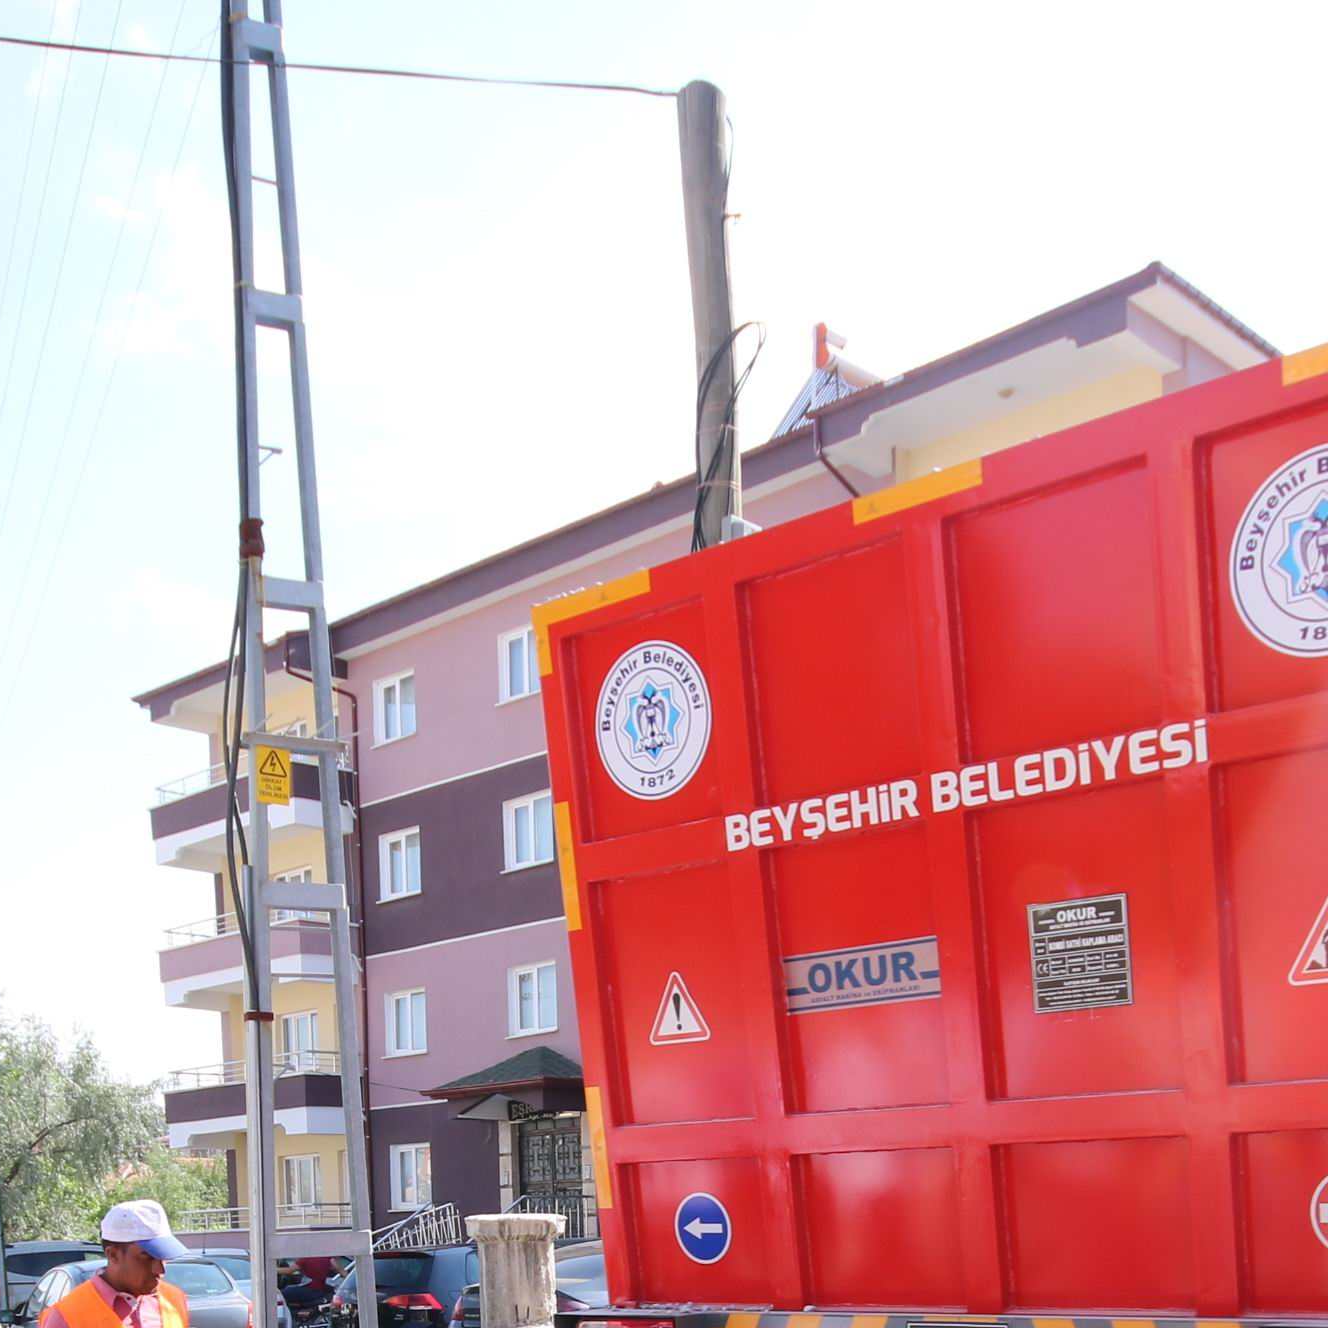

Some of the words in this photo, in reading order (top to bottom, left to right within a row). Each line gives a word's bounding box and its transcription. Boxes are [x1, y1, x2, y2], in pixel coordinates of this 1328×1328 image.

[1239, 468, 1307, 571] Beyşehir
[642, 650, 705, 710] Belediyesi
[639, 768, 676, 788] 1872
[724, 778, 920, 852] BEYŞEHİR
[929, 718, 1210, 814] BELEDİYESİ
[1056, 906, 1097, 923] OKUR
[807, 950, 918, 994] OKUR
